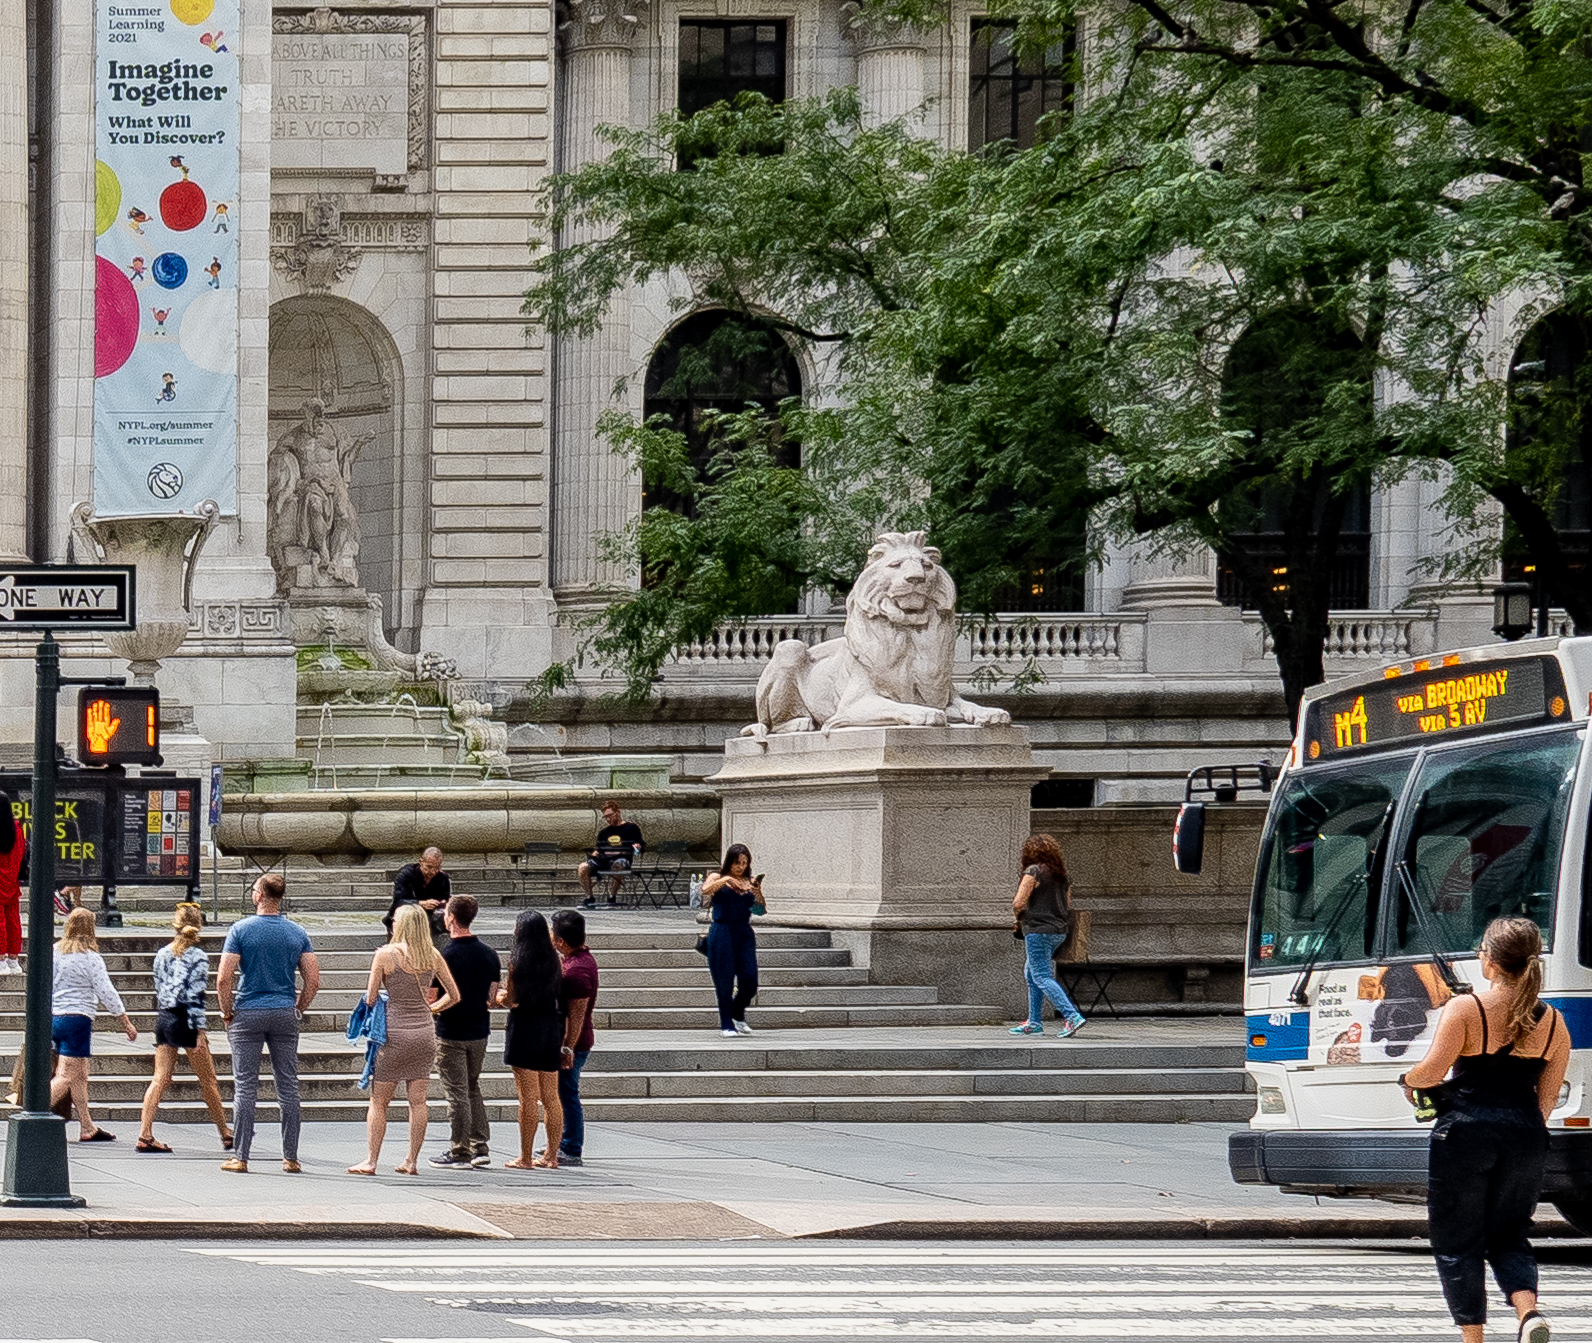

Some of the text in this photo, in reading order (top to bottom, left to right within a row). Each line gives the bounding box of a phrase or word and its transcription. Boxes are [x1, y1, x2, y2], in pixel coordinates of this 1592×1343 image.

[108, 6, 162, 17] Summer
[108, 19, 165, 32] Learning
[108, 33, 137, 43] 2021
[322, 43, 345, 58] ALL
[350, 42, 405, 58] THINGS
[108, 58, 214, 85] Imagine
[291, 69, 353, 85] TRUTH
[107, 81, 228, 107] Together
[272, 94, 392, 111] ARETH AWAY
[108, 115, 192, 128] What Will
[273, 121, 383, 137] HE VICTORY
[108, 131, 226, 145] You Discover?
[118, 420, 213, 432] NYPL.org/summer
[58, 588, 105, 608] WAY
[1426, 669, 1508, 709] BROADWAY
[1334, 695, 1367, 747] M4
[1448, 703, 1461, 728] 5
[1464, 698, 1486, 726] AV
[11, 801, 78, 819] BLCK
